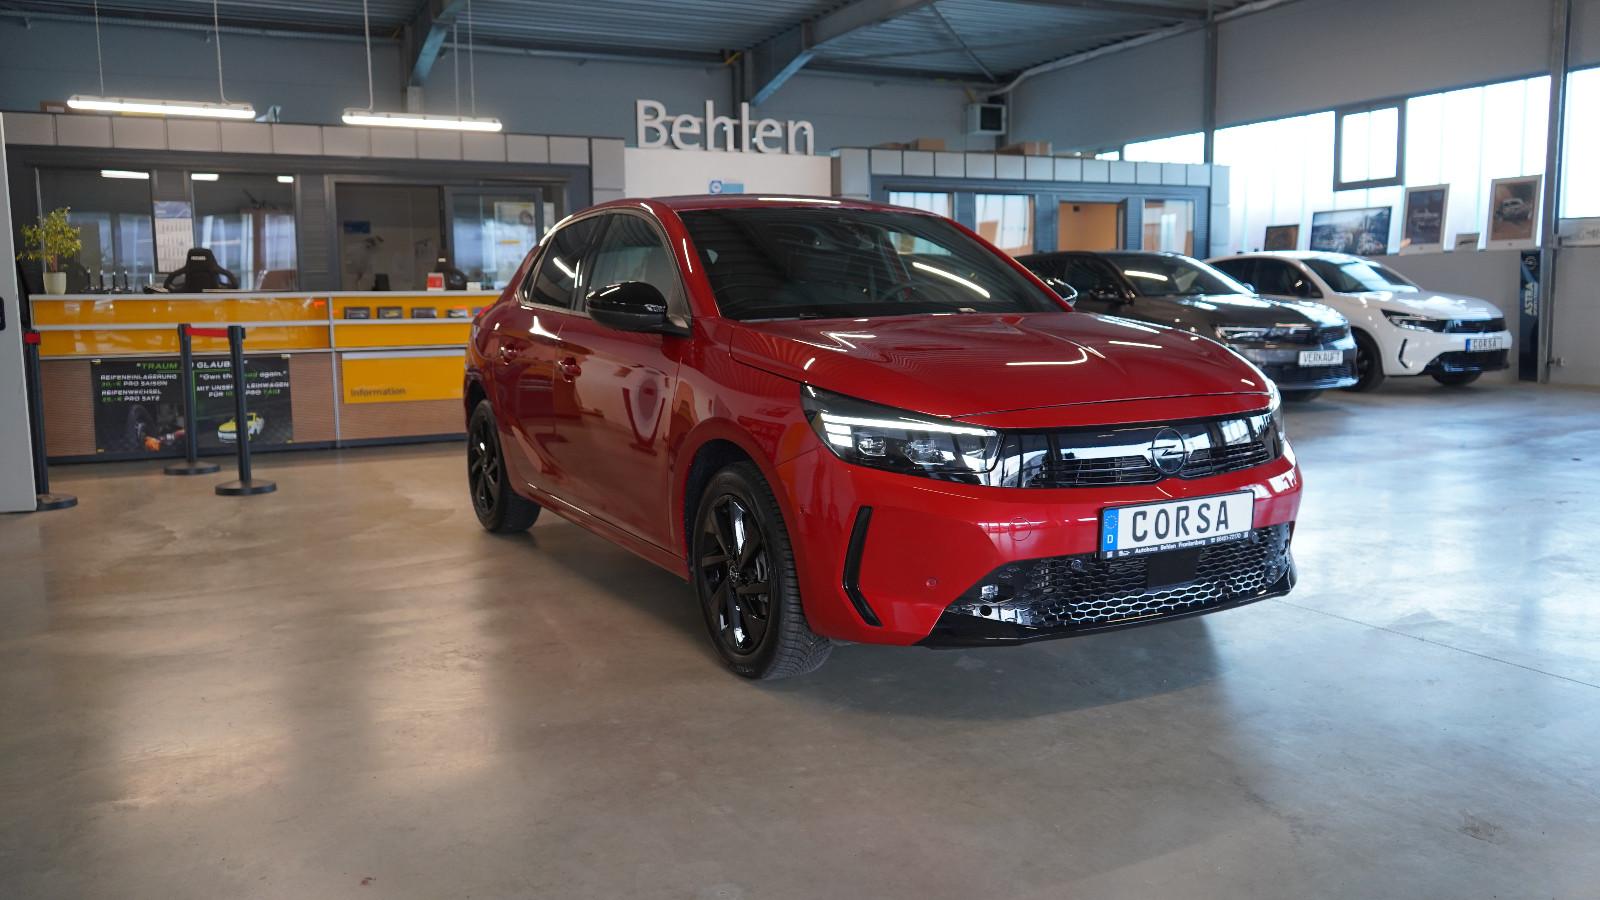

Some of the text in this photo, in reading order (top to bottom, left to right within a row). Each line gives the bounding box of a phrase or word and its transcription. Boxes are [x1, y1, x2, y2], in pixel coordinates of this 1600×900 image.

[633, 99, 815, 156] Behlen
[1524, 282, 1534, 316] ASTRA
[1107, 500, 1229, 544] D CORSA
